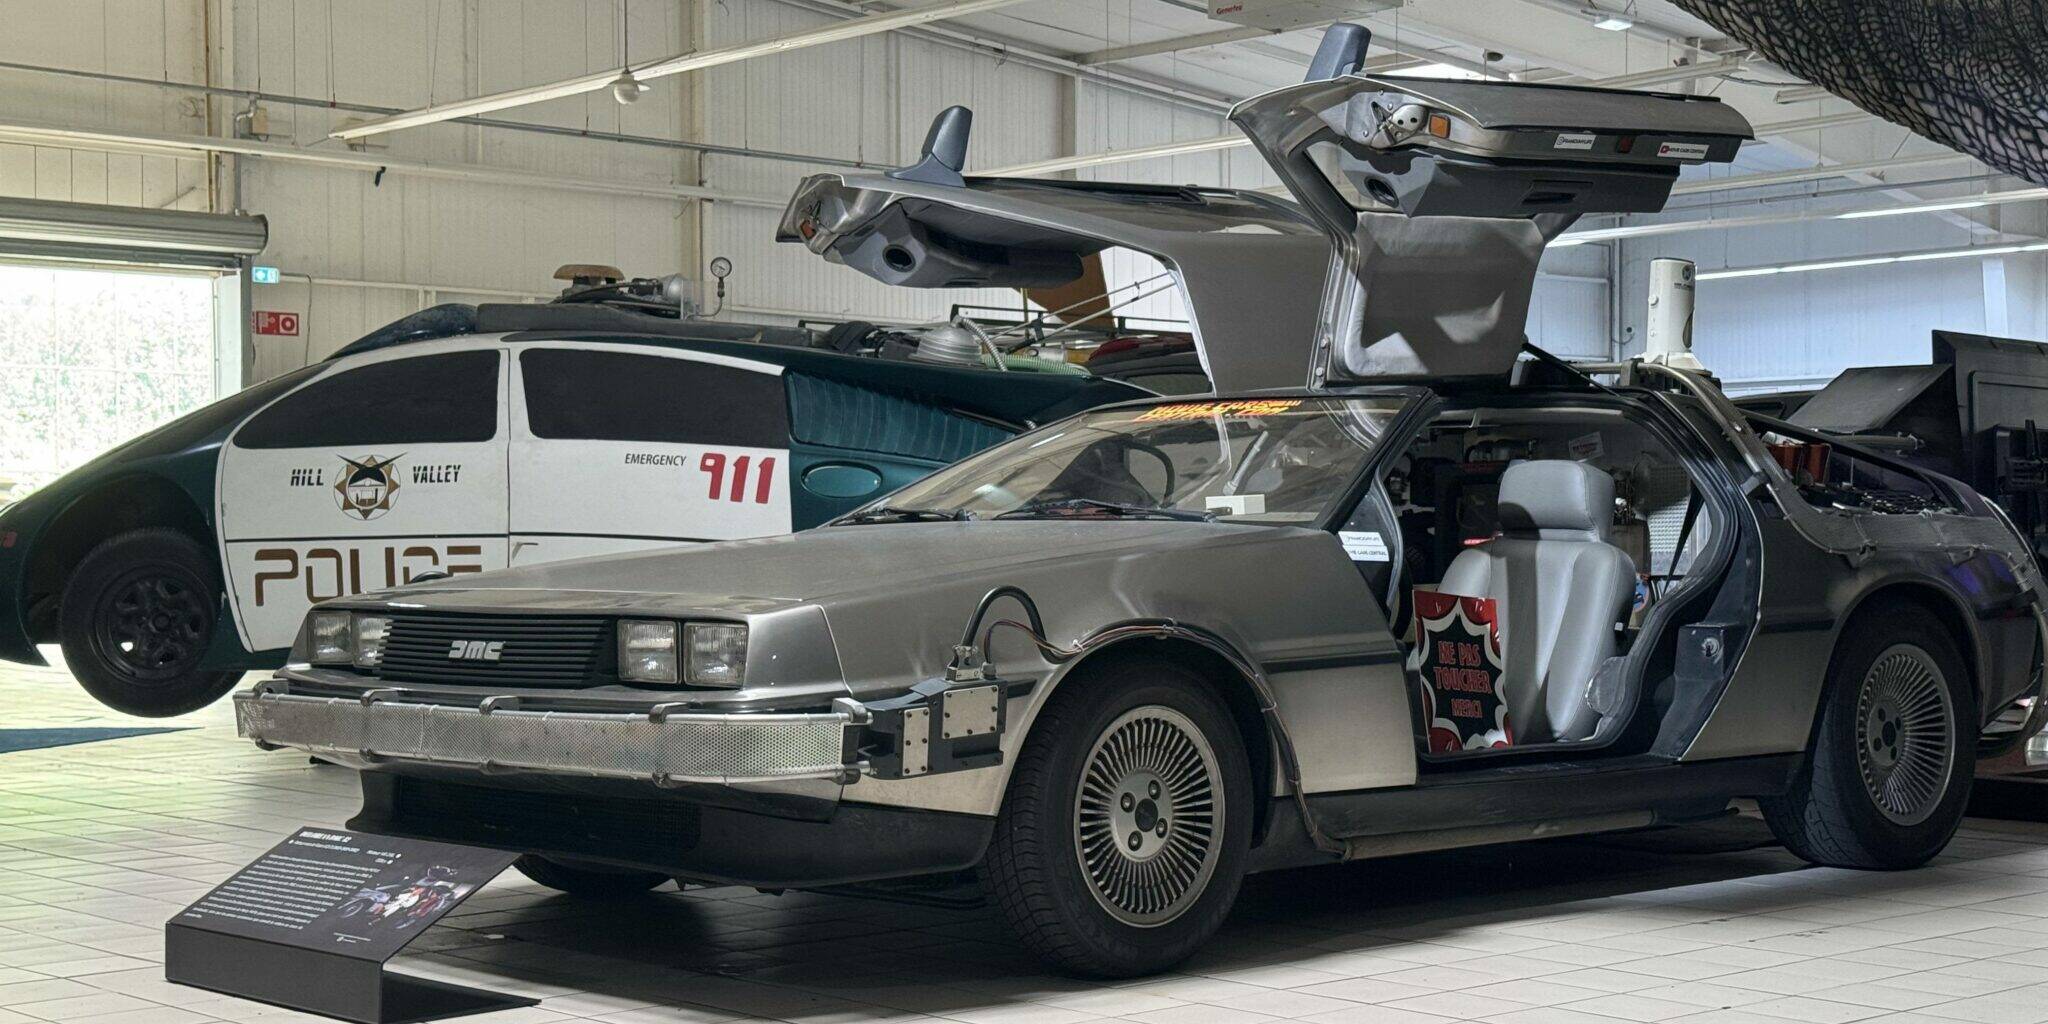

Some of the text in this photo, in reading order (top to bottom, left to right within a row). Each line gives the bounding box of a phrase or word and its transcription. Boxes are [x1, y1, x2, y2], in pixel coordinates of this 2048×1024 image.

[290, 464, 461, 487] HILL VALLEY
[624, 452, 776, 504] EMERGENCY 911
[448, 640, 506, 660] DMC
[1438, 640, 1481, 667] NE PAS
[1433, 667, 1493, 694] TOUCHER
[1451, 698, 1483, 719] MERCI
